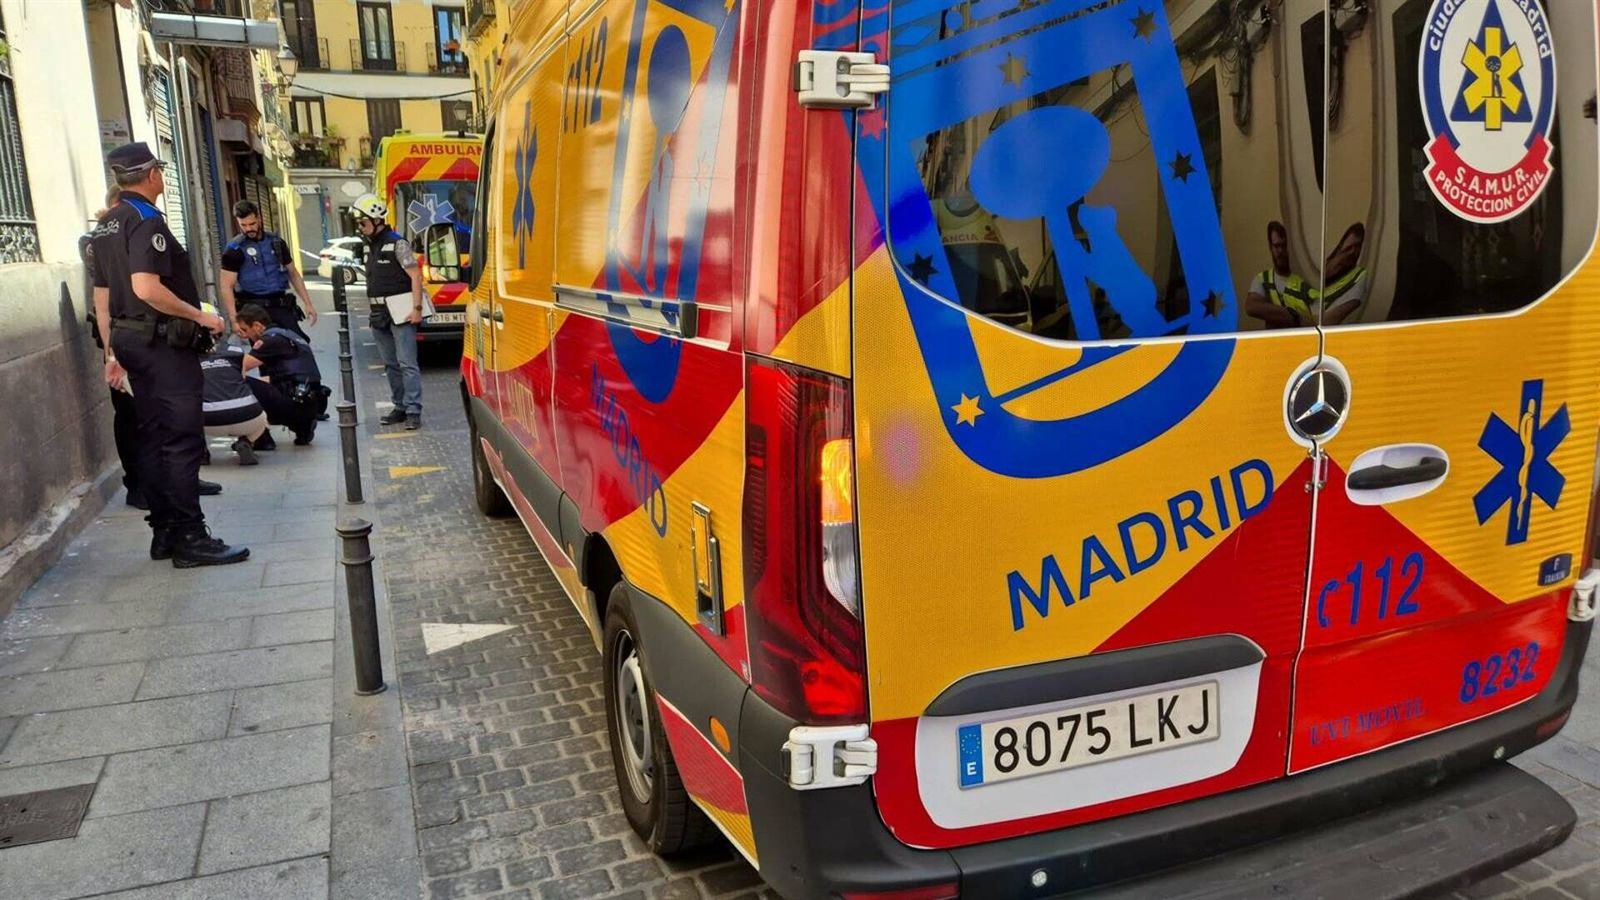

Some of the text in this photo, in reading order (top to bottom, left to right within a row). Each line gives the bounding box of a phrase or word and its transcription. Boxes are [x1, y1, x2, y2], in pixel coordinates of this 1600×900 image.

[1435, 169, 1544, 213] PROTECCION CIVIL
[1455, 166, 1529, 196] S.A.M.U.R.
[591, 360, 667, 538] MADRID
[1007, 458, 1275, 632] MADRID
[1346, 551, 1424, 626] 112
[1459, 641, 1539, 702] 8232
[994, 689, 1209, 773] 8075 LKJ
[967, 761, 977, 776] E
